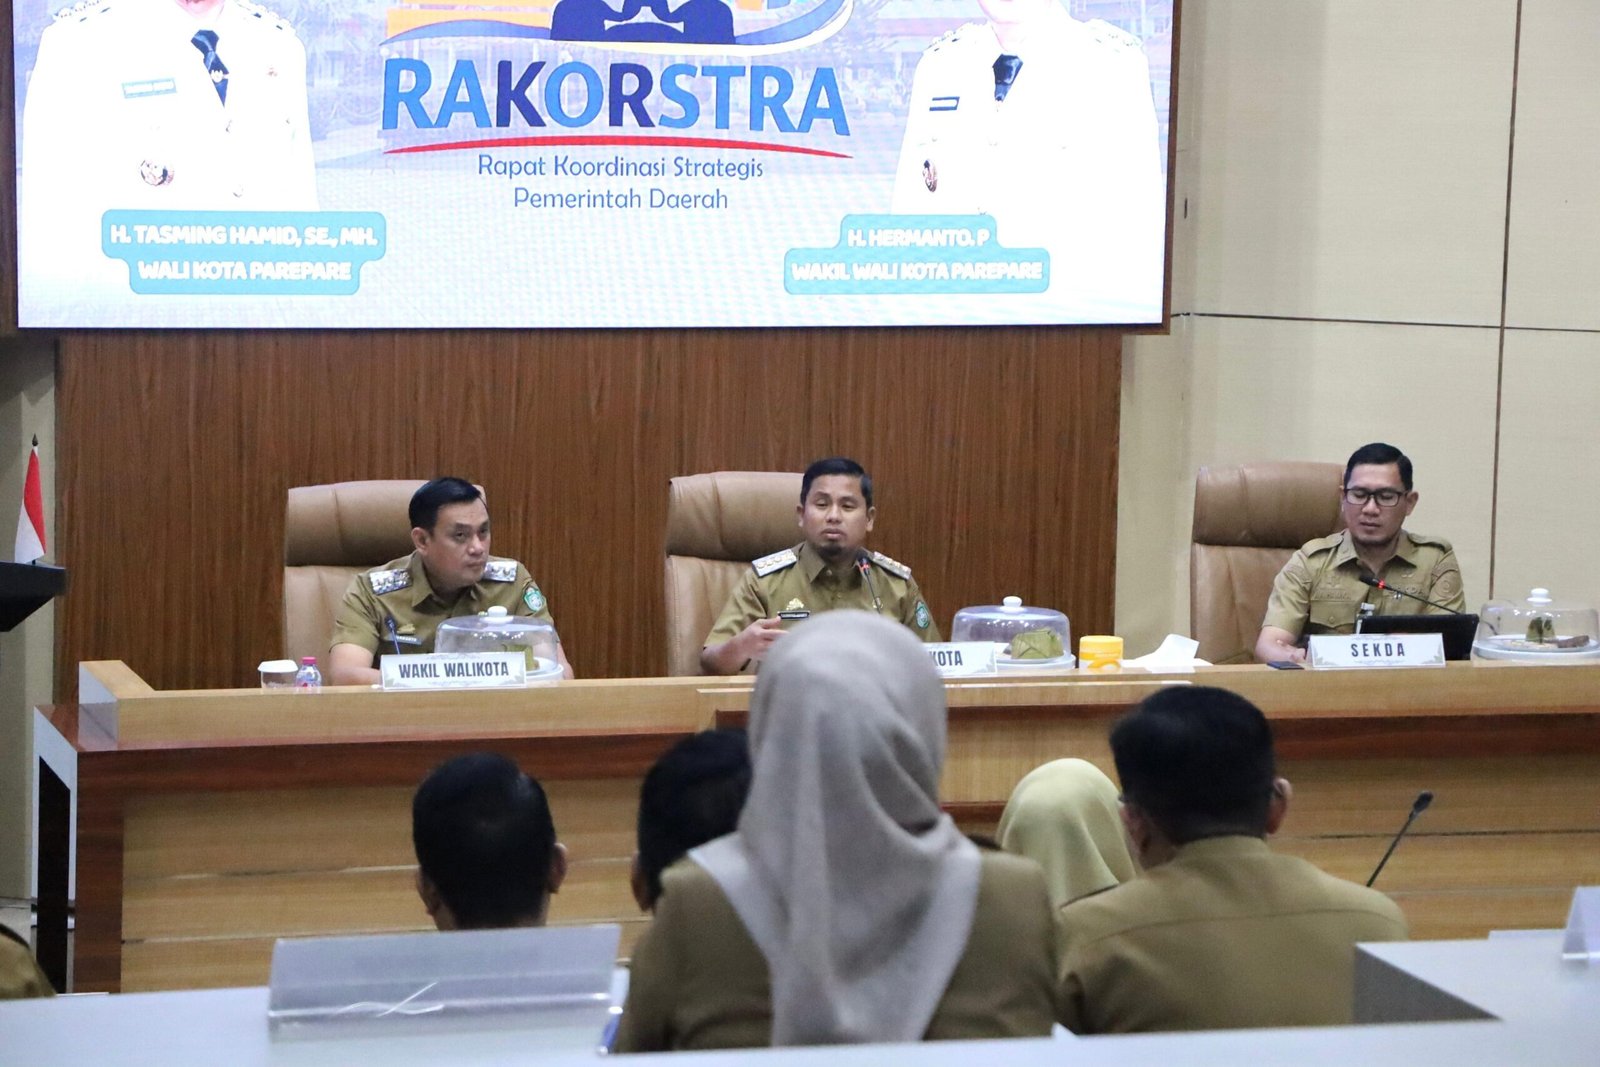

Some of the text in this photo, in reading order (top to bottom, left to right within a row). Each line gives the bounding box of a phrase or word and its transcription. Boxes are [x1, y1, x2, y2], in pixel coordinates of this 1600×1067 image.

[383, 58, 851, 136] RAKORSTRA
[478, 154, 764, 180] Rapat Koordinasi Strategis
[514, 187, 728, 209] Pemerintah Daerah
[110, 225, 132, 244] H.
[134, 225, 227, 245] TASMING
[230, 226, 302, 248] HAMID,
[847, 229, 867, 247] H.
[977, 229, 990, 246] P
[138, 261, 351, 281] WALI KOTA PAREPARE
[792, 262, 1043, 281] WAKIL WALI KOTA PAREPARE
[1350, 642, 1405, 658] SEKDA
[399, 661, 509, 678] WAKIL WALIKOTA
